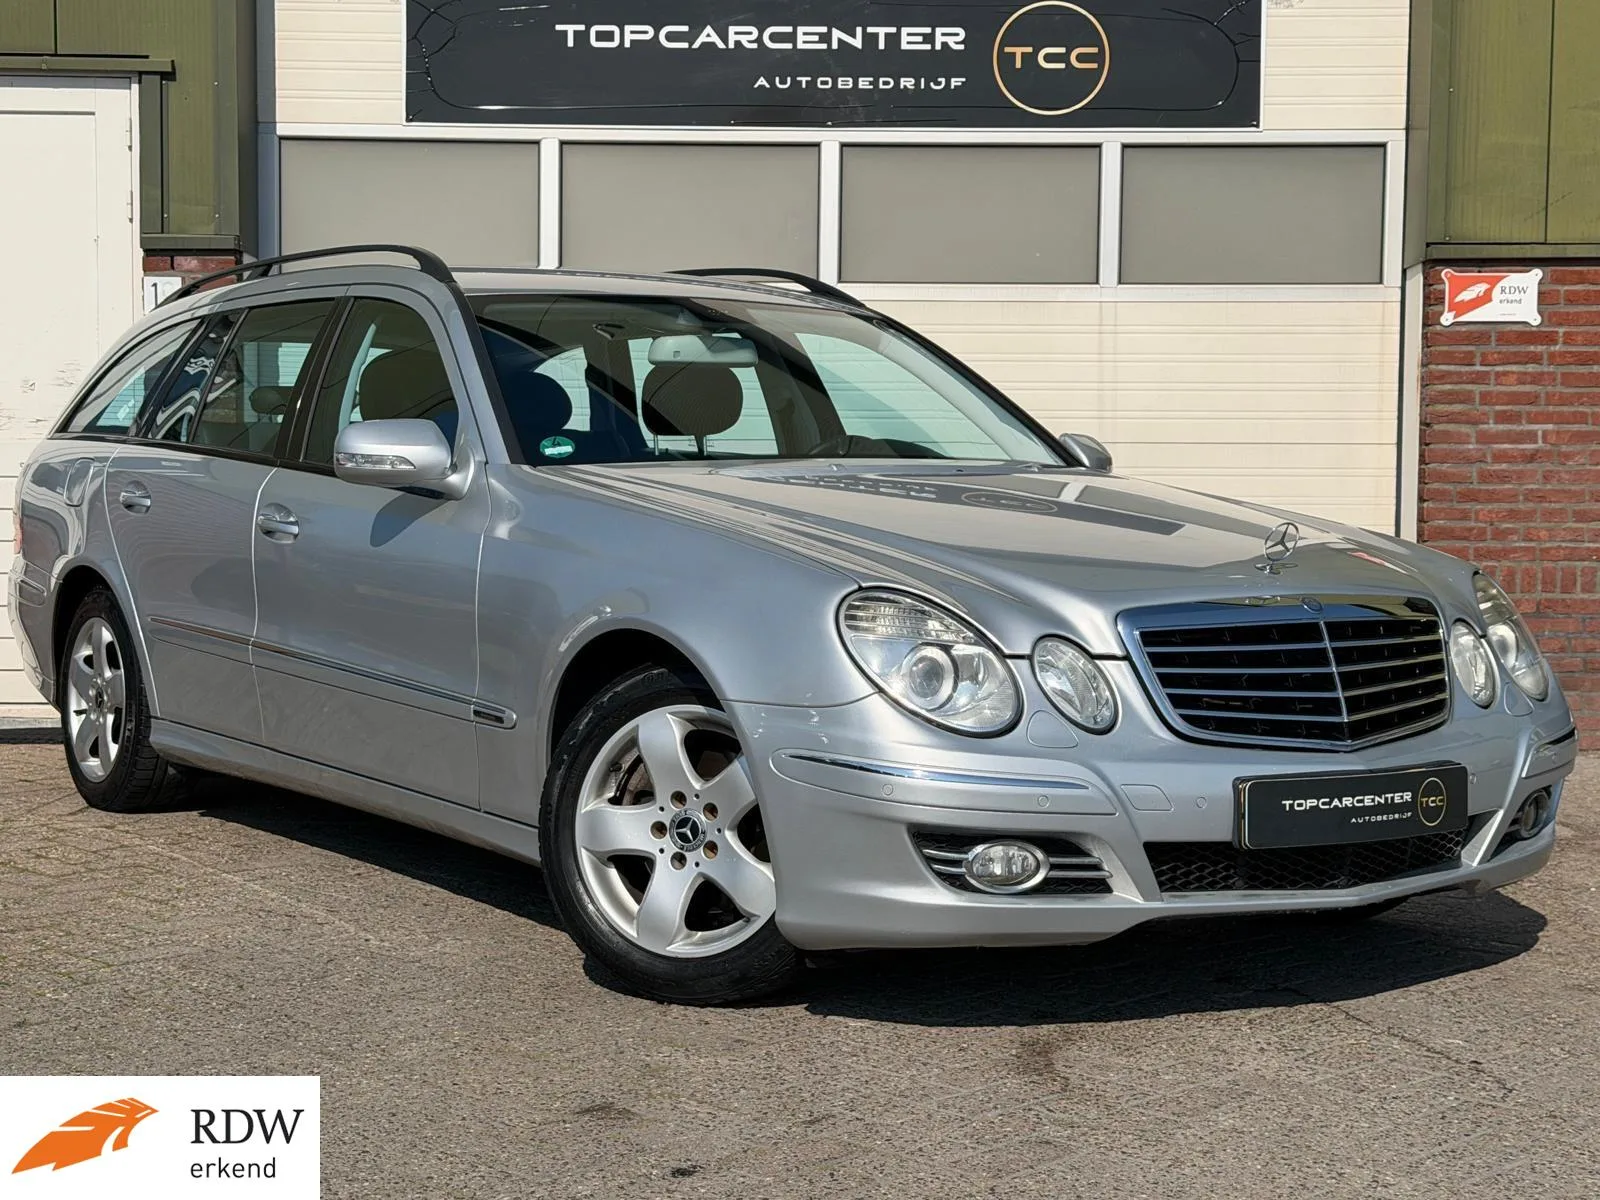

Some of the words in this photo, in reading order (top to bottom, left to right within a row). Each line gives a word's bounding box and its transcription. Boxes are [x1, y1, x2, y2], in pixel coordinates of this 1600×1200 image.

[555, 24, 966, 51] TOPCARCENTER
[1004, 46, 1100, 70] TCC
[753, 76, 967, 90] AUTOBEDRIJF
[1500, 285, 1529, 295] RDW
[1281, 791, 1412, 811] TOPCARCENTER
[1421, 796, 1444, 807] TCC
[1350, 811, 1413, 824] AUTOBEDRIJF
